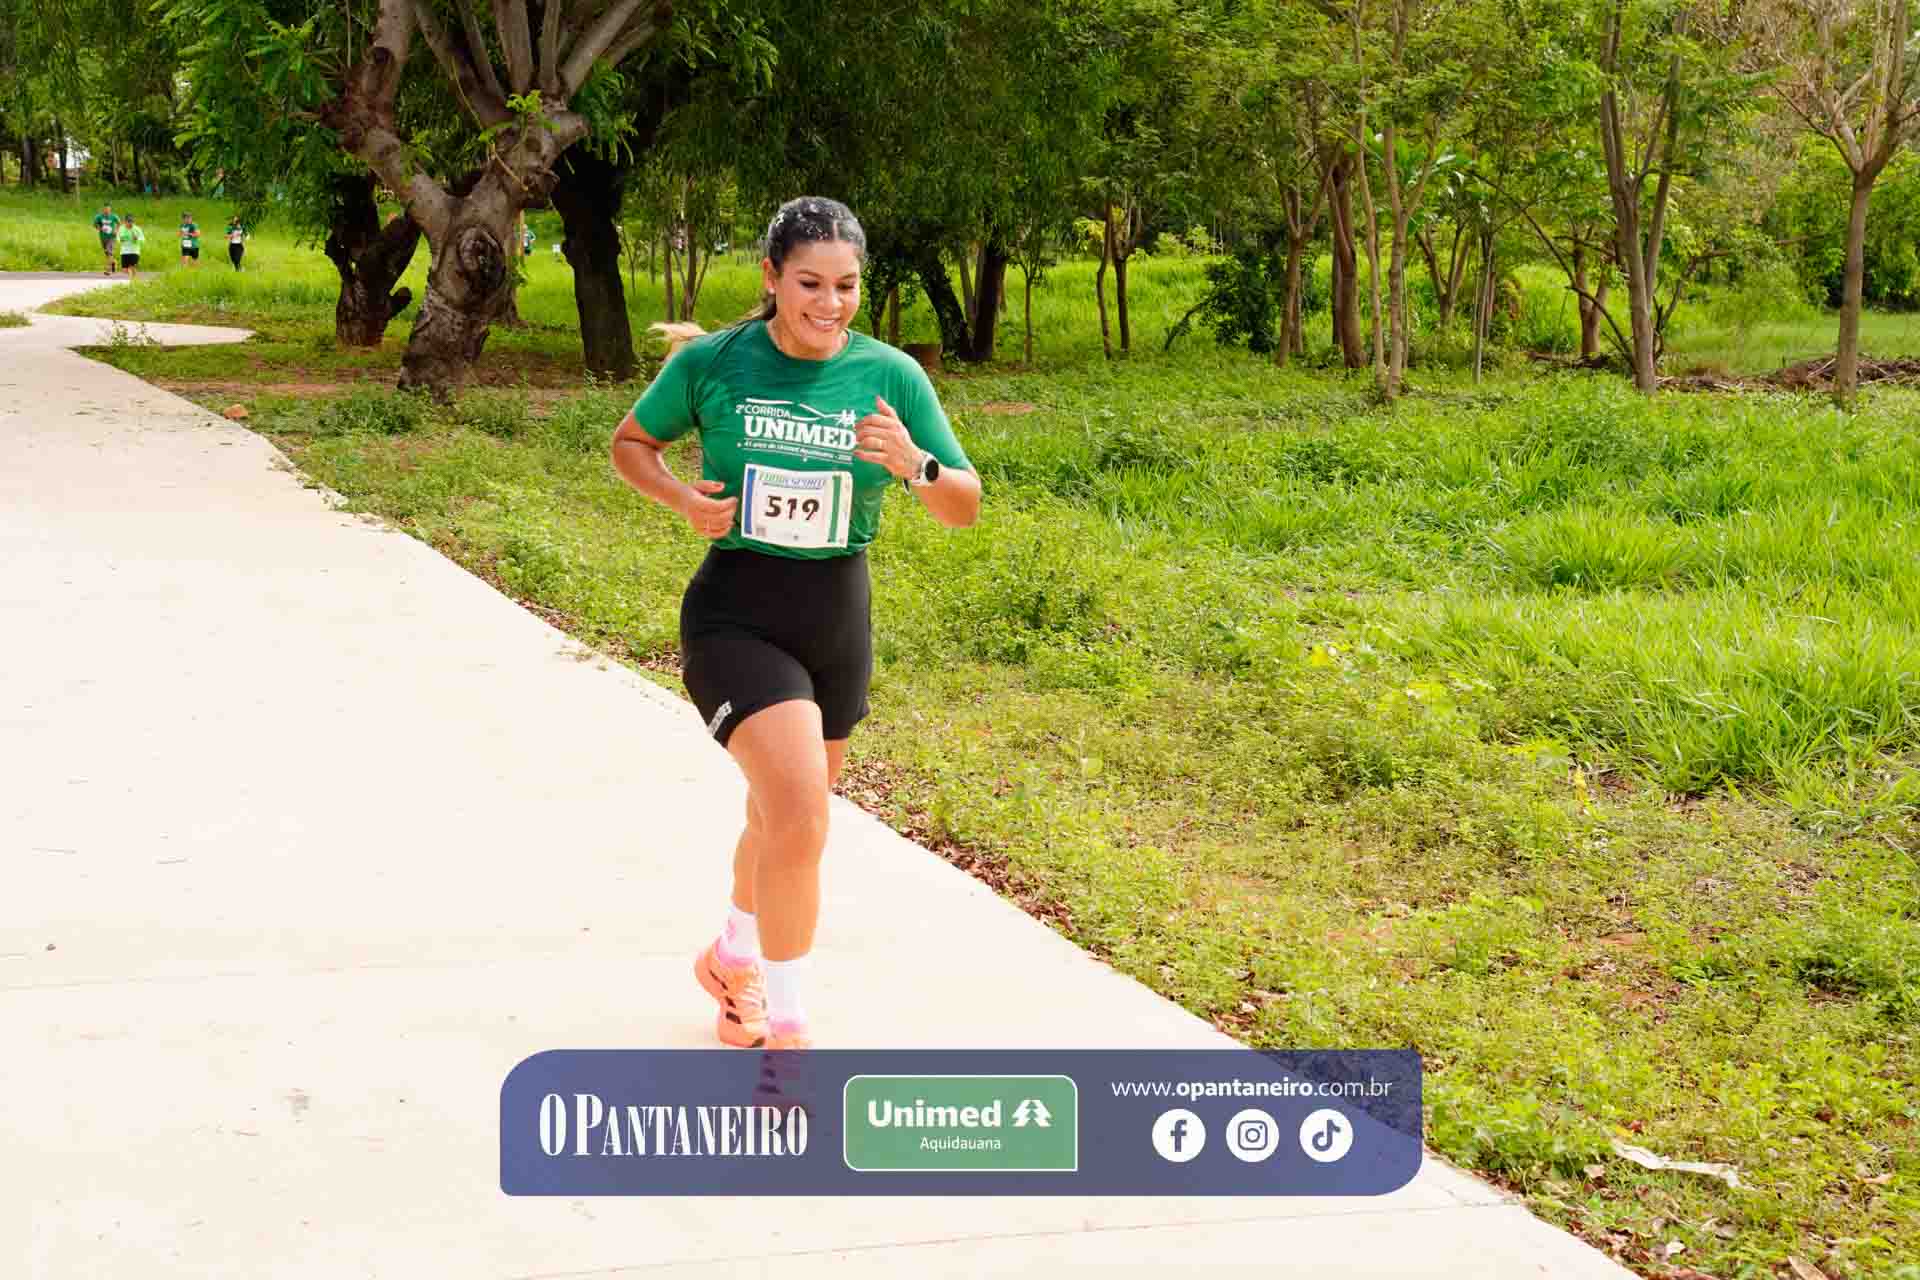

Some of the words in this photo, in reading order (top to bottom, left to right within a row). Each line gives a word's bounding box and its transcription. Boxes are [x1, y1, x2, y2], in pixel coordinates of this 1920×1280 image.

[744, 404, 791, 418] CORRIDA
[744, 415, 857, 451] UNIMED
[764, 495, 820, 520] 519
